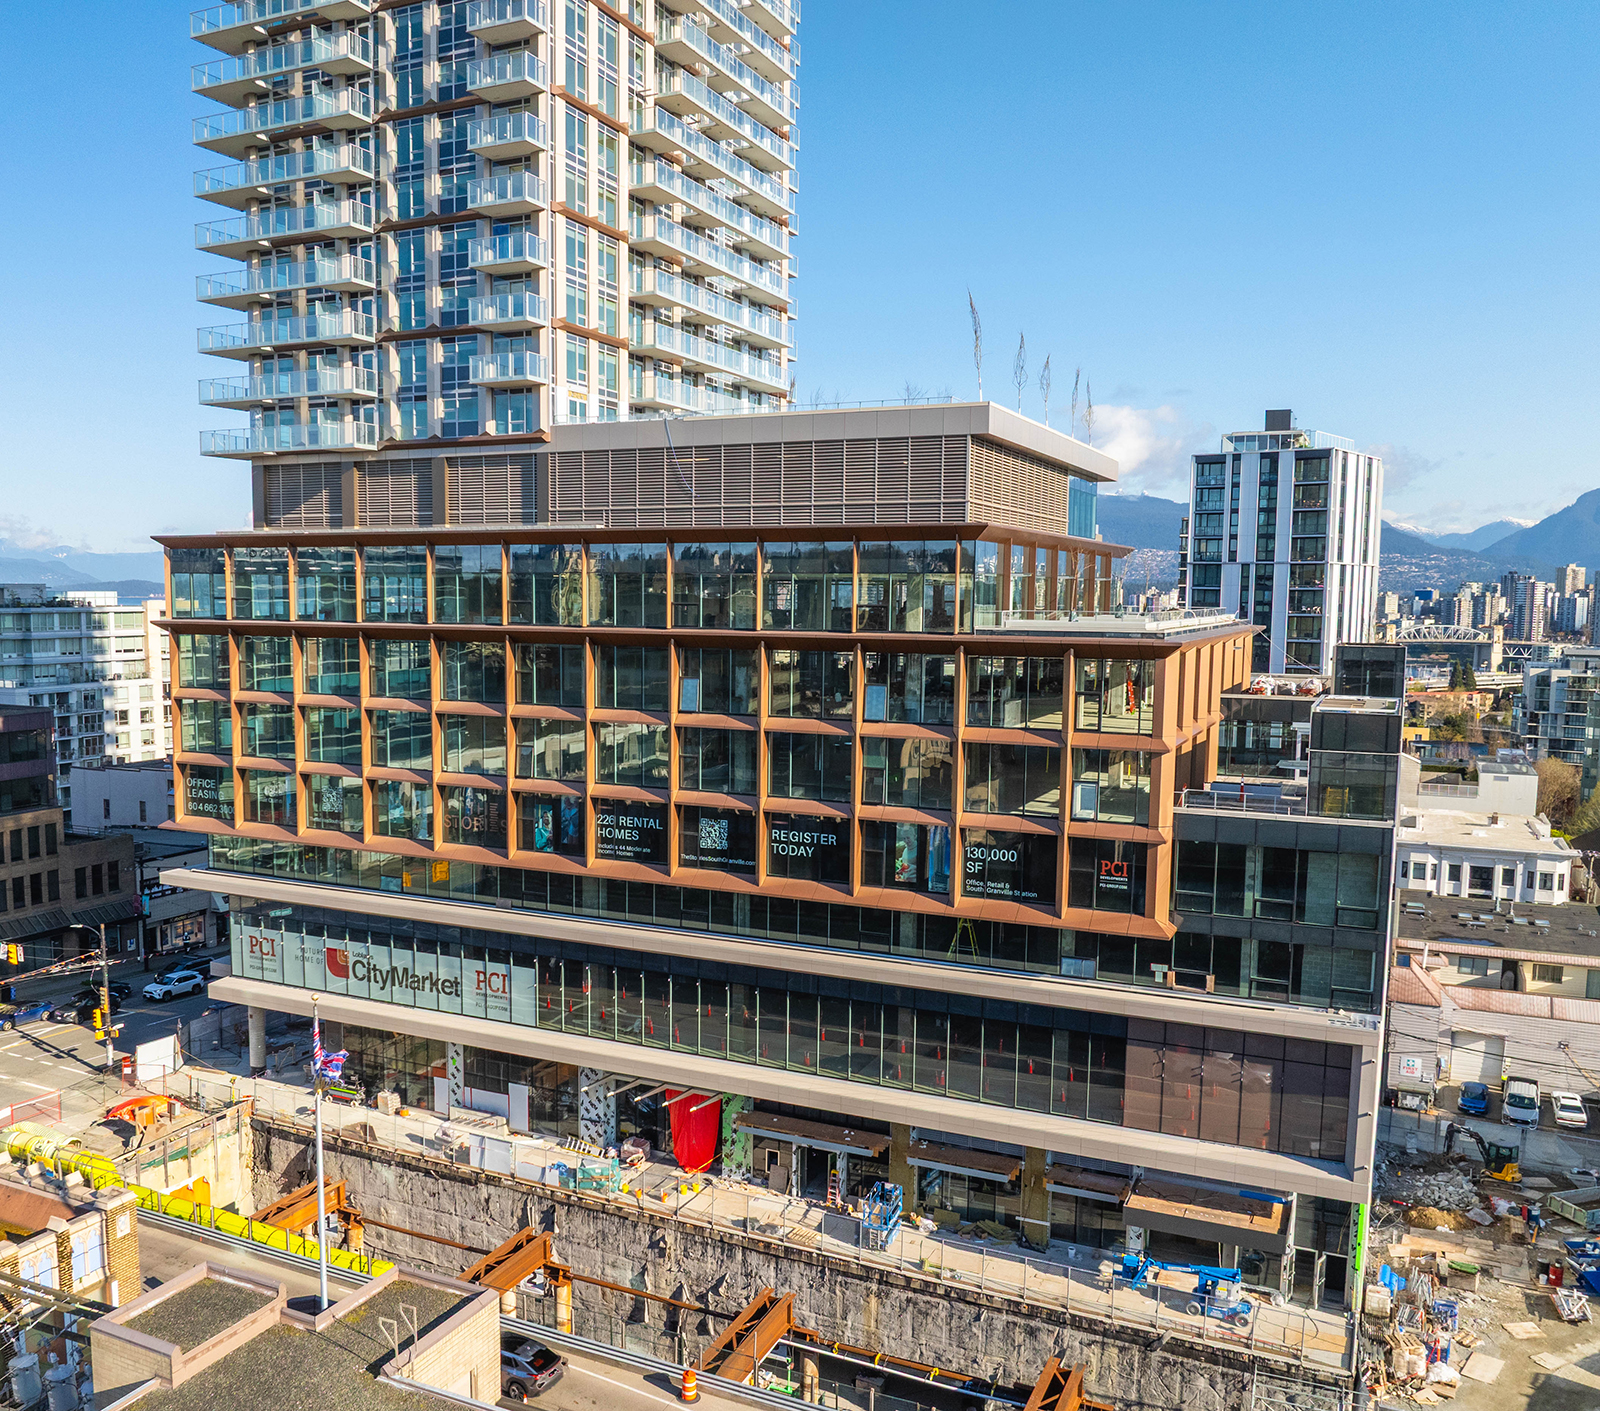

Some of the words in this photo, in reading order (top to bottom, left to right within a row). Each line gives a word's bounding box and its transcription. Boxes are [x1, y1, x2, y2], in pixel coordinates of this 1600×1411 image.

[186, 777, 216, 789] OFFICE
[187, 788, 225, 801] LEASING
[188, 801, 203, 811] 604
[204, 803, 218, 813] 662
[597, 814, 615, 825] 226
[619, 816, 663, 830] RENTAL
[597, 827, 639, 841] HOMES
[771, 829, 837, 846] REGISTER
[771, 843, 815, 858] TODAY
[964, 846, 1018, 862] 130,000
[966, 861, 983, 873] SF
[1100, 860, 1128, 877] PCI
[966, 885, 984, 893] South
[986, 887, 1013, 896] Granville
[1013, 889, 1038, 898] Station
[987, 881, 1004, 889] Retail
[248, 935, 276, 957] PCI
[294, 954, 314, 964] HOME
[315, 957, 324, 965] OF
[352, 959, 461, 998] CityMarket
[475, 970, 508, 995] PCI
[476, 992, 508, 1001] DEVEOPMENTS
